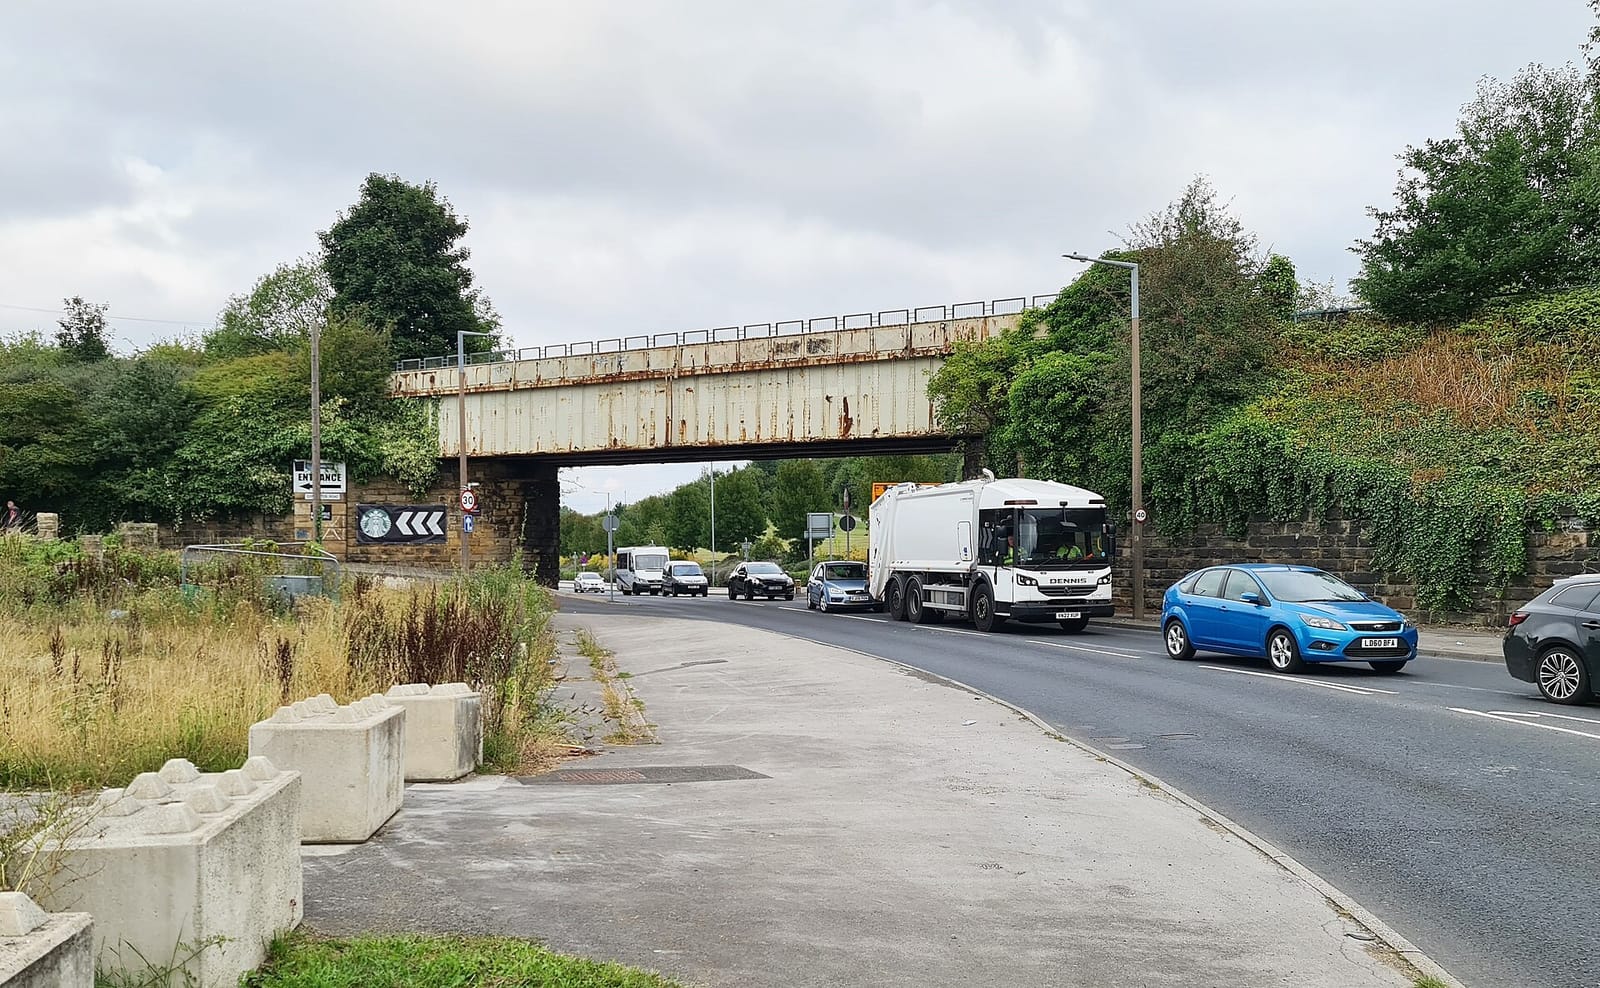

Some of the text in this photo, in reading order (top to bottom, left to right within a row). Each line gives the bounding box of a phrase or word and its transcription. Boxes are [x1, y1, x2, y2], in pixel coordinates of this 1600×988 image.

[298, 473, 342, 482] ENTANCE
[463, 496, 473, 505] 30
[1049, 577, 1087, 585] DENNIS
[1364, 639, 1395, 647] LD60 BFA
